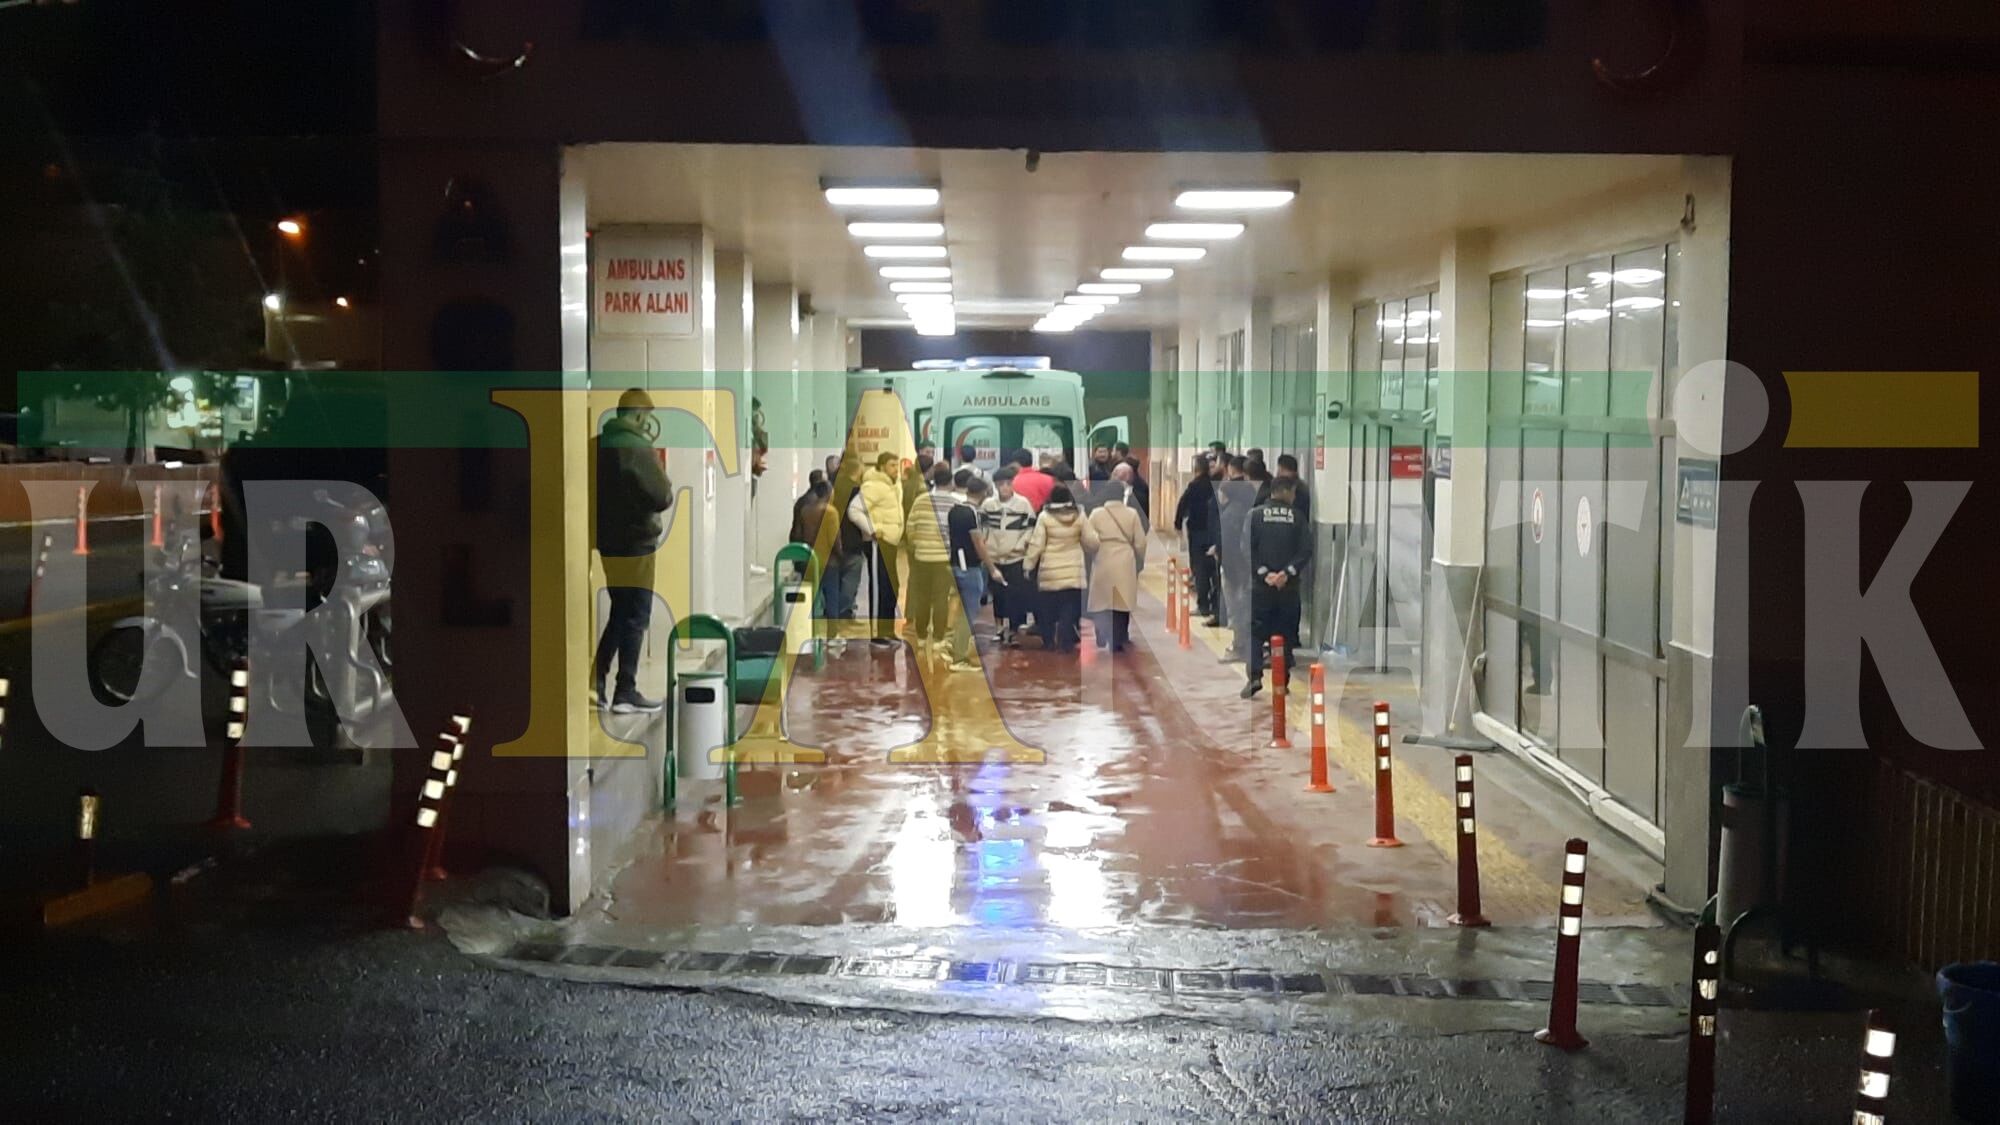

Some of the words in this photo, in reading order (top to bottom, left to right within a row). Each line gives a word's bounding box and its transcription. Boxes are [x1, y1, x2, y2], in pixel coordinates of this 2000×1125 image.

[607, 258, 685, 280] AMBULANS
[605, 292, 641, 313] PARK
[647, 292, 688, 313] ALANI
[963, 395, 1050, 407] AMBULANS
